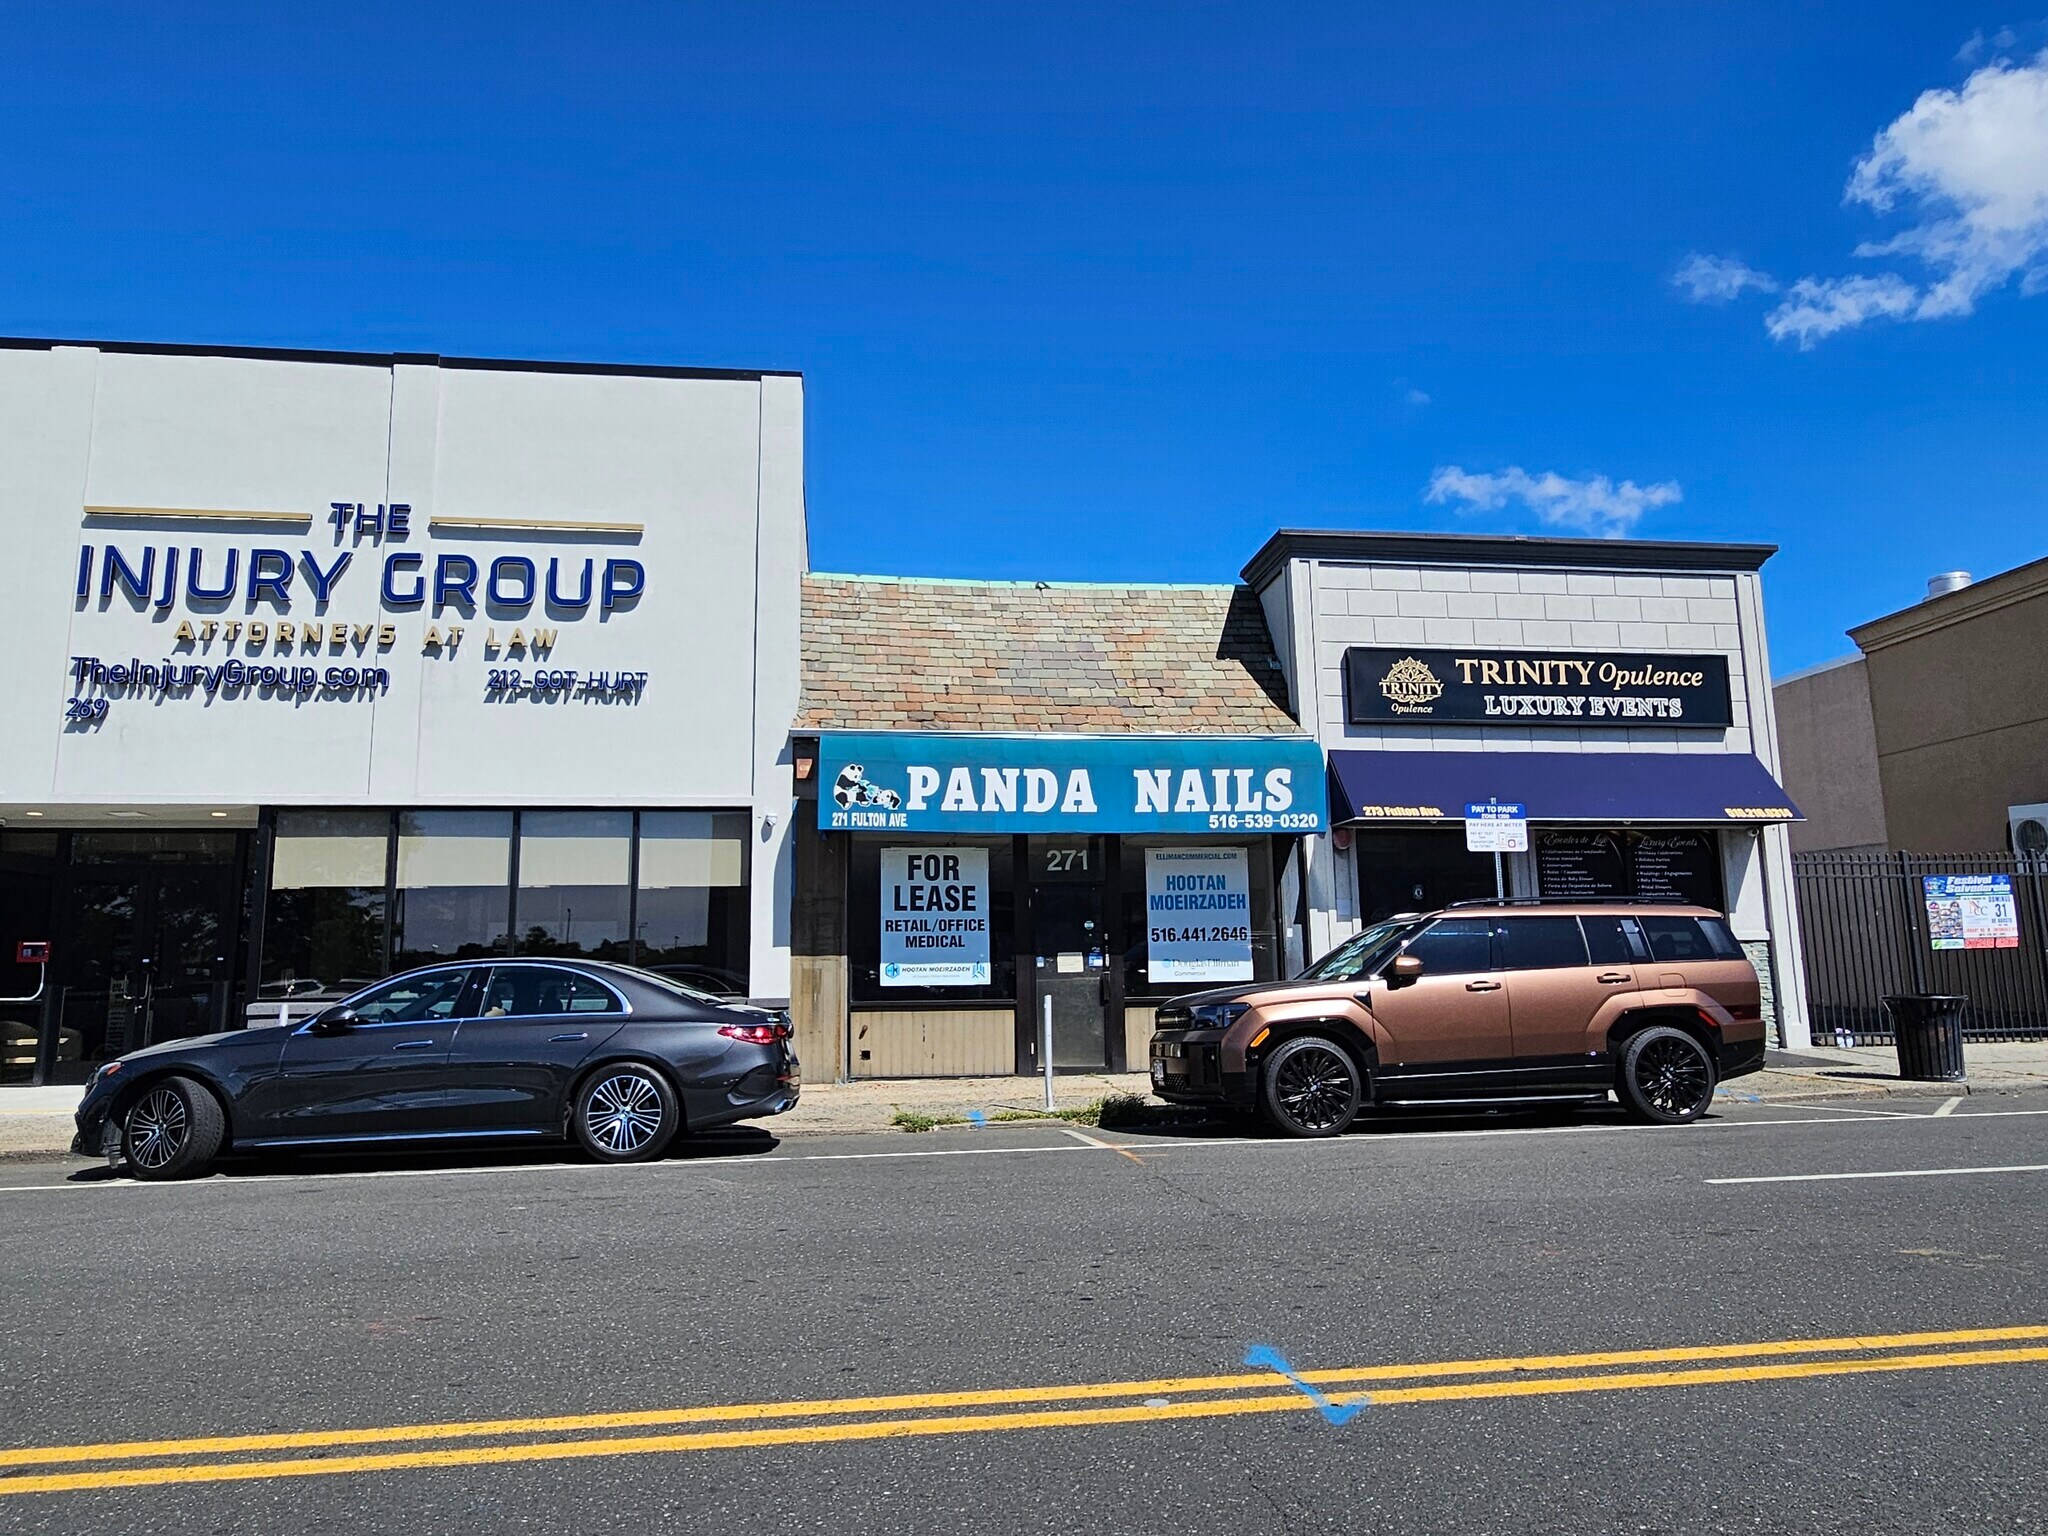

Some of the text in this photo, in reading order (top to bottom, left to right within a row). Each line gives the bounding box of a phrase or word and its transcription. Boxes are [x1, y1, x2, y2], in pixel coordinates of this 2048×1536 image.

[331, 502, 411, 532] THE
[77, 545, 645, 608] INJURY GROUP
[173, 620, 558, 648] ATTORNEYS AT LAW
[71, 656, 390, 692] TheInjuryGroup.com
[487, 669, 648, 691] 212-GOT-HURT
[1455, 658, 1703, 690] TRINITY Opulence
[1378, 681, 1445, 695] TRINITY
[65, 698, 108, 718] 269
[1391, 703, 1433, 714] Opulence
[1484, 695, 1683, 718] LUXURY EVENTS
[906, 766, 1293, 813] PANDA NAILS
[831, 812, 848, 828] 271
[851, 812, 887, 827] FULTON
[1209, 813, 1318, 829] 516-539-0320
[1046, 849, 1088, 871] 271
[1155, 852, 1238, 860] ELLIMANCOMMERCIAL.COM
[908, 854, 960, 881] FOR
[1166, 875, 1226, 891] HOOTAN
[893, 885, 977, 912] LEASE
[1150, 893, 1246, 911] MOEIRZADEH
[1995, 903, 2007, 918] 31
[885, 918, 986, 933] RETAIL/OFFICE
[1151, 926, 1248, 942] 516.441.2646
[905, 935, 965, 948] MEDICAL
